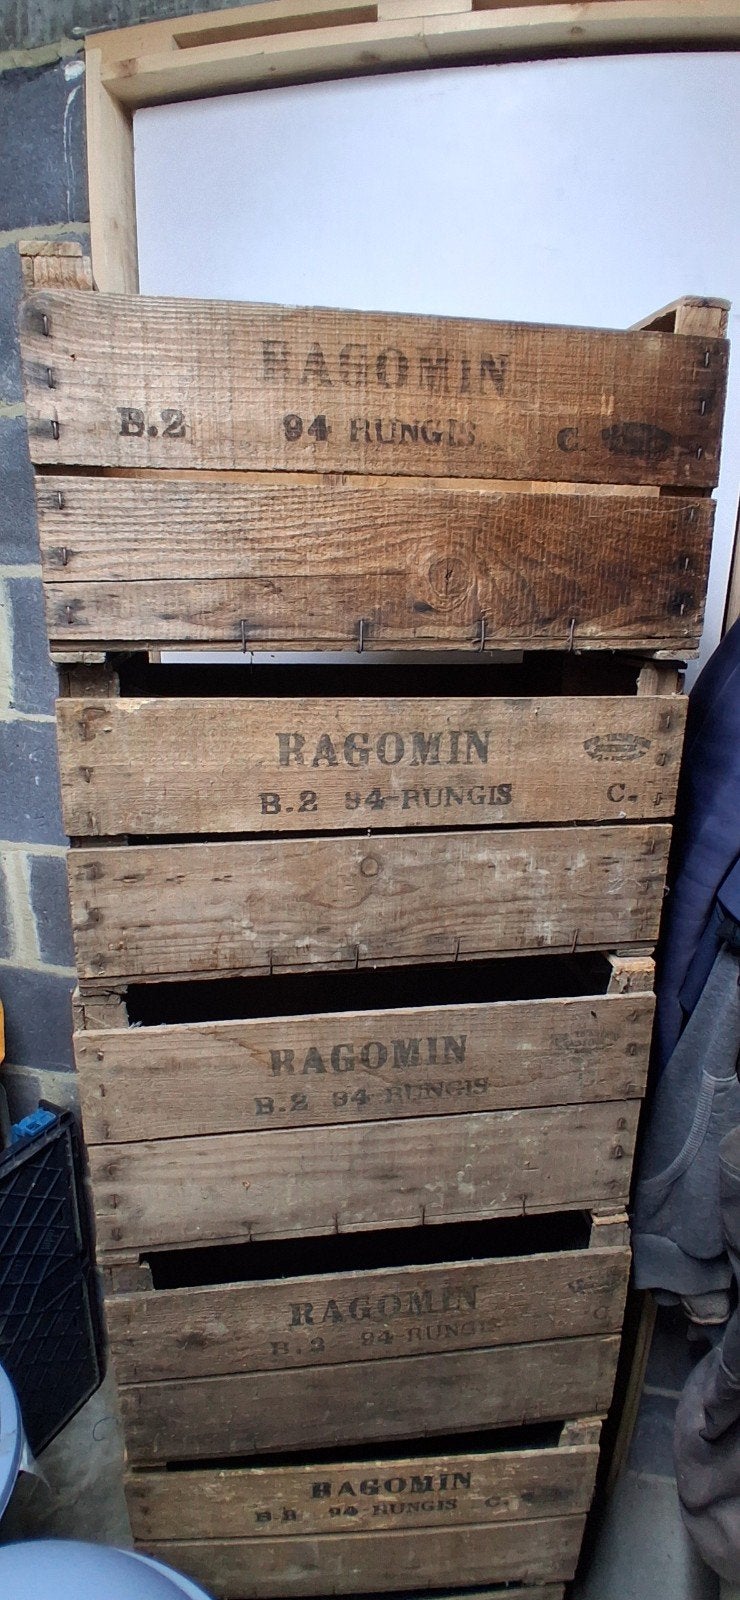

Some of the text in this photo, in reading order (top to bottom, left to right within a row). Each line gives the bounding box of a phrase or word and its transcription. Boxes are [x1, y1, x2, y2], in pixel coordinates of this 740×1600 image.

[116, 407, 187, 438] B.2
[283, 413, 332, 442] 94
[350, 417, 477, 448] RUNGIS
[275, 730, 492, 768] RAGOMIN
[259, 790, 319, 815] B.2
[269, 1034, 468, 1077] RAGOMIN
[254, 1092, 309, 1116] B.2
[288, 1284, 480, 1328] RAGOMIN
